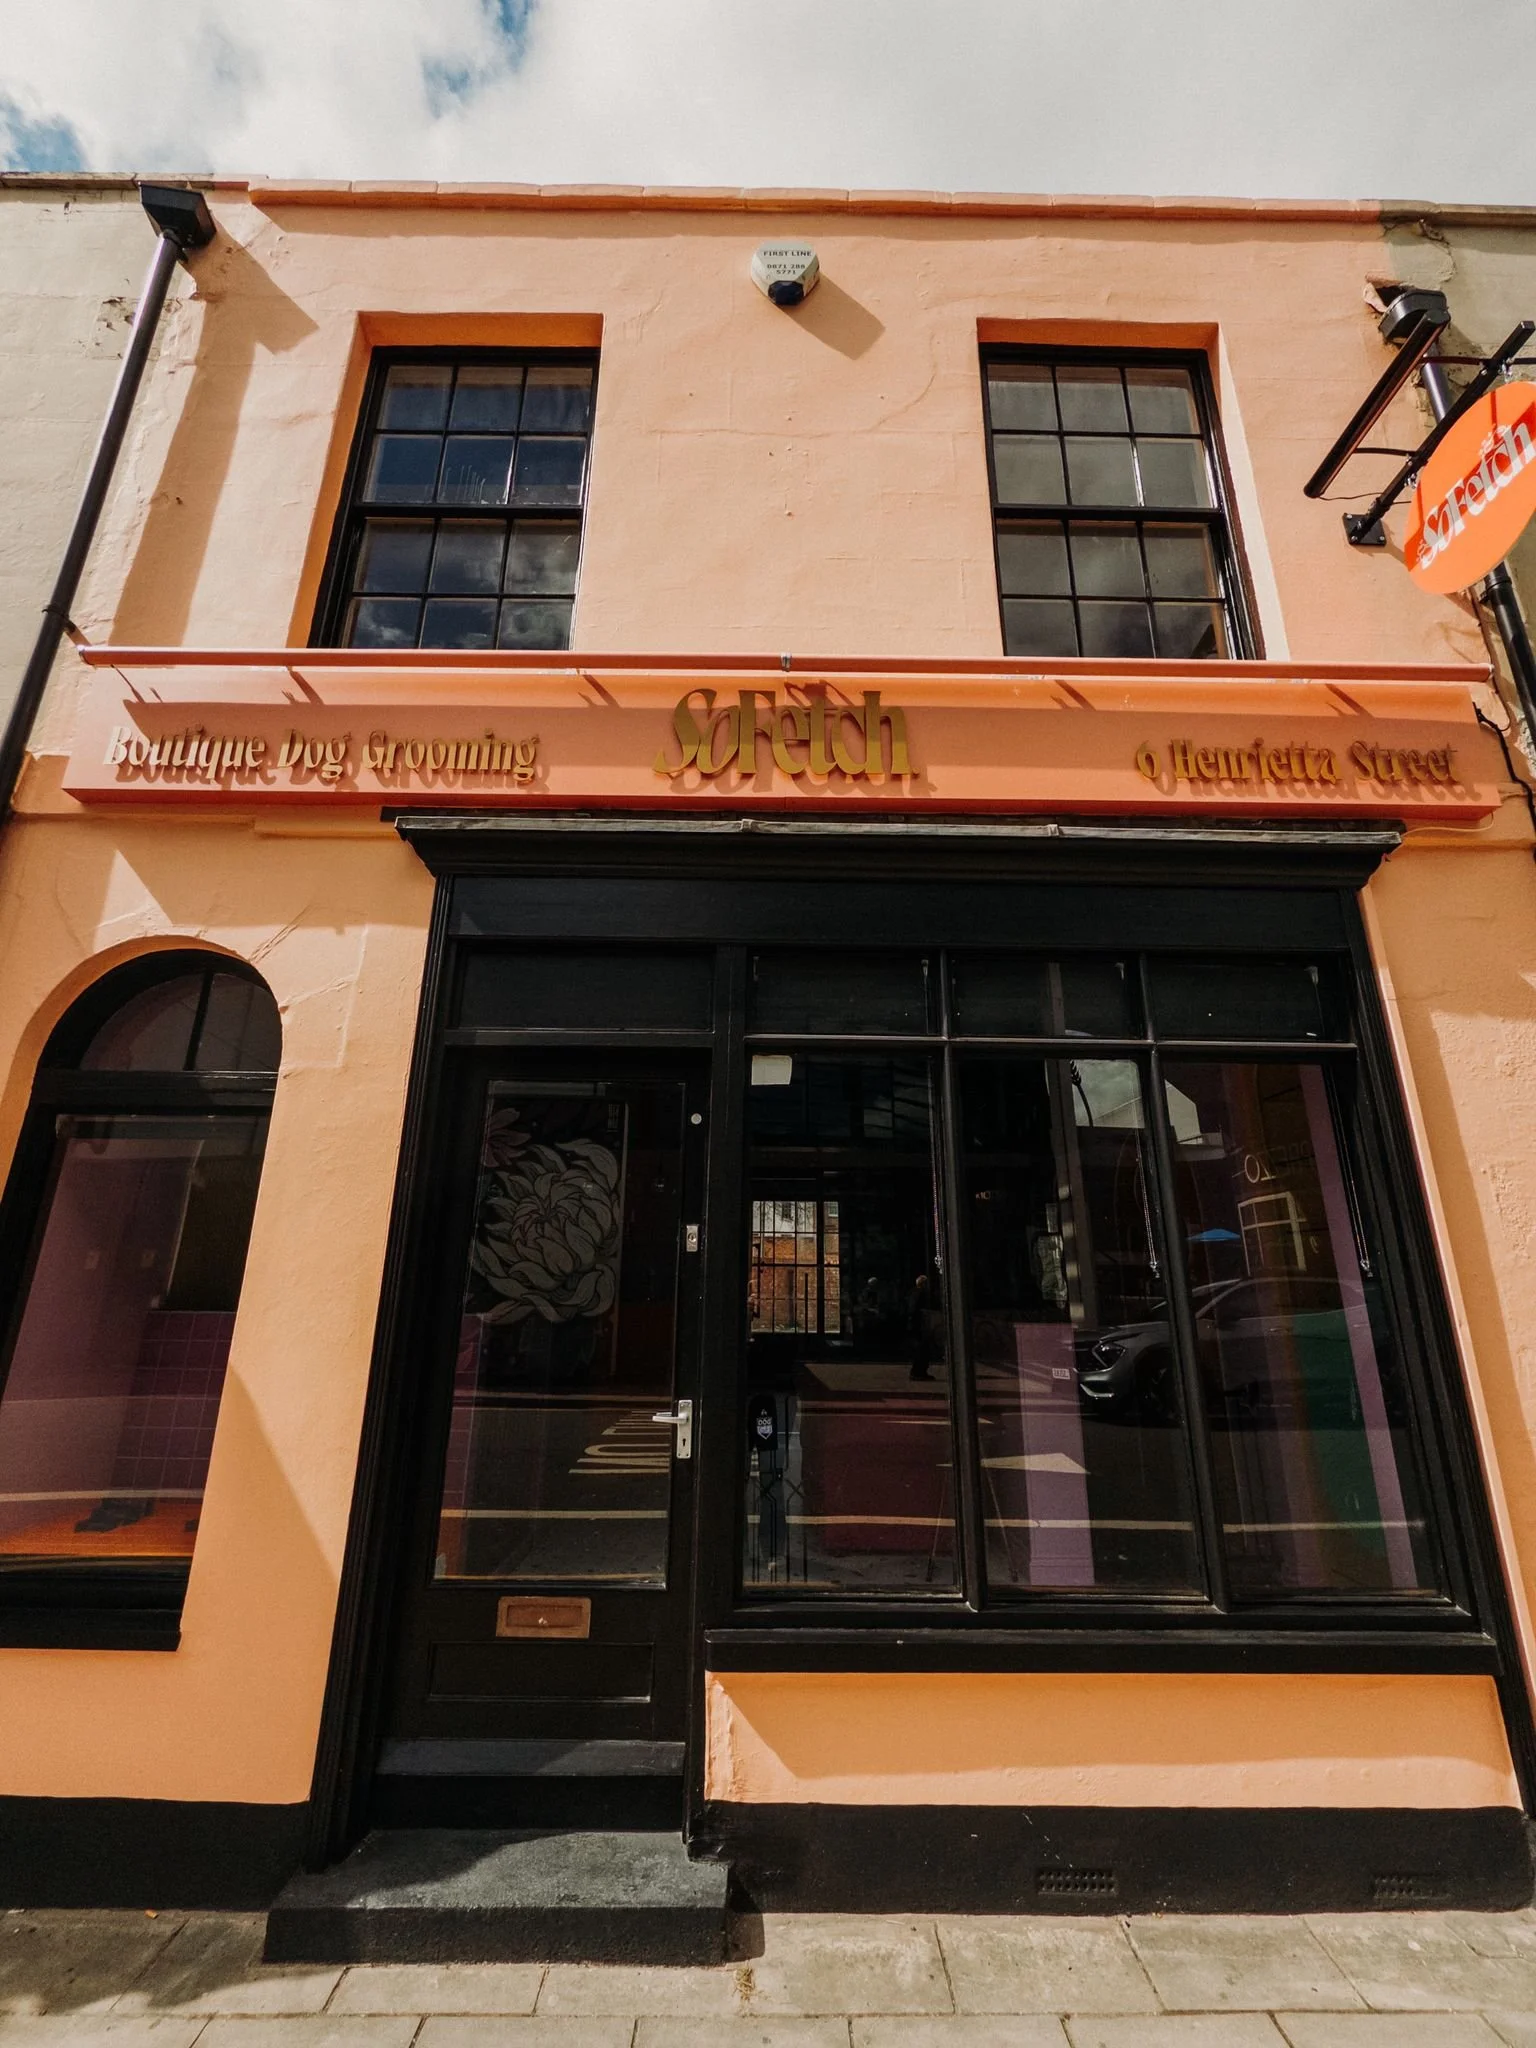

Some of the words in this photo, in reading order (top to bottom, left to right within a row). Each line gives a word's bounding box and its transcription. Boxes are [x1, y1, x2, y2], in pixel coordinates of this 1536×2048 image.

[103, 725, 266, 779] Boutique
[277, 728, 352, 779] Dog
[362, 727, 541, 785] Grooming
[1136, 741, 1161, 779] 6
[1171, 737, 1343, 784] Henrietta
[1349, 740, 1458, 782] Street
